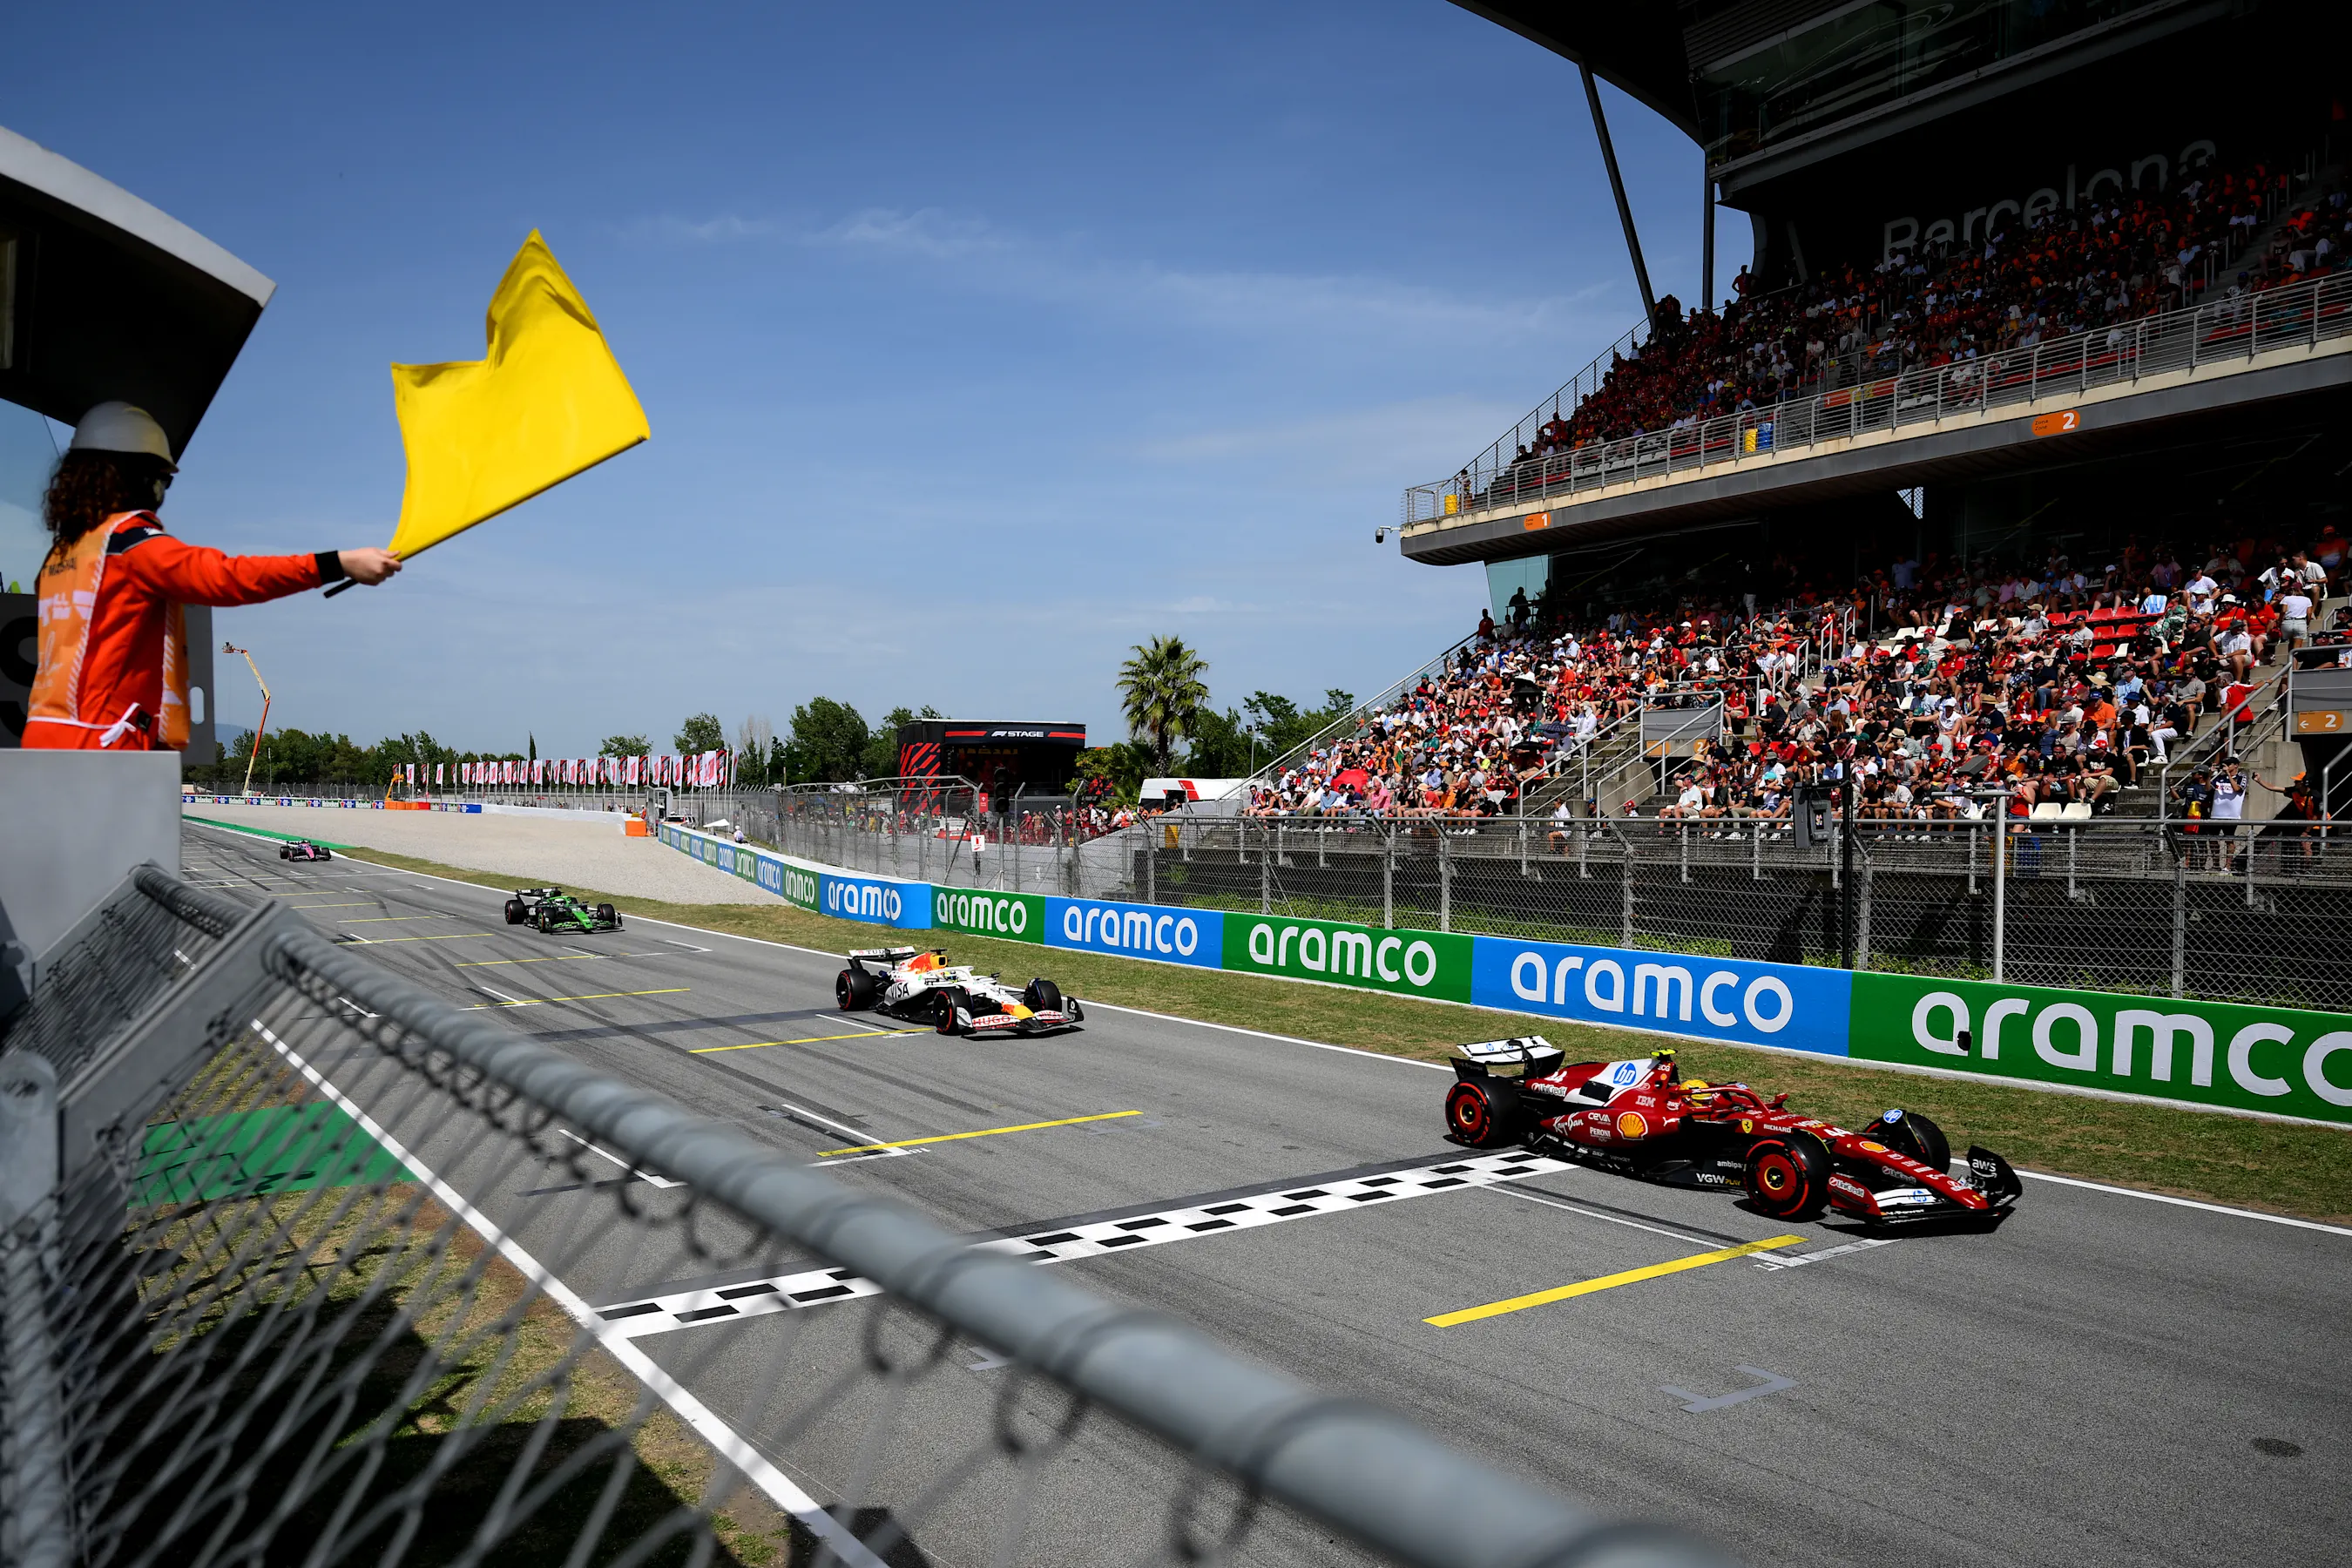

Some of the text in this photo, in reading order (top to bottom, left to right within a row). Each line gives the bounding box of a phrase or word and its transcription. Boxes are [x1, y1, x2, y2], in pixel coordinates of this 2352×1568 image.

[2062, 412, 2075, 430] 2
[1541, 513, 1548, 526] 1
[2324, 713, 2336, 728] 2
[758, 860, 781, 890] aramco
[786, 870, 815, 904] aramco
[828, 881, 902, 921] aramco
[936, 893, 1027, 935] aramco
[1064, 905, 1199, 957] aramco
[1248, 923, 1436, 987] aramco
[890, 982, 910, 999] VISA
[1511, 951, 1794, 1033] aramco
[972, 1015, 1010, 1026] HUGO
[1912, 991, 2352, 1106] aramco
[1614, 1062, 1637, 1086] hp
[1538, 1083, 1568, 1098] UniCredit
[1635, 1095, 1656, 1108] IBM
[1763, 1123, 1792, 1133] RICHARD
[1823, 1127, 1854, 1137] 44
[1716, 1160, 1743, 1169] ambipa
[1972, 1159, 1997, 1173] aws
[1695, 1173, 1726, 1184] VGW
[1836, 1179, 1865, 1198] UniCredit
